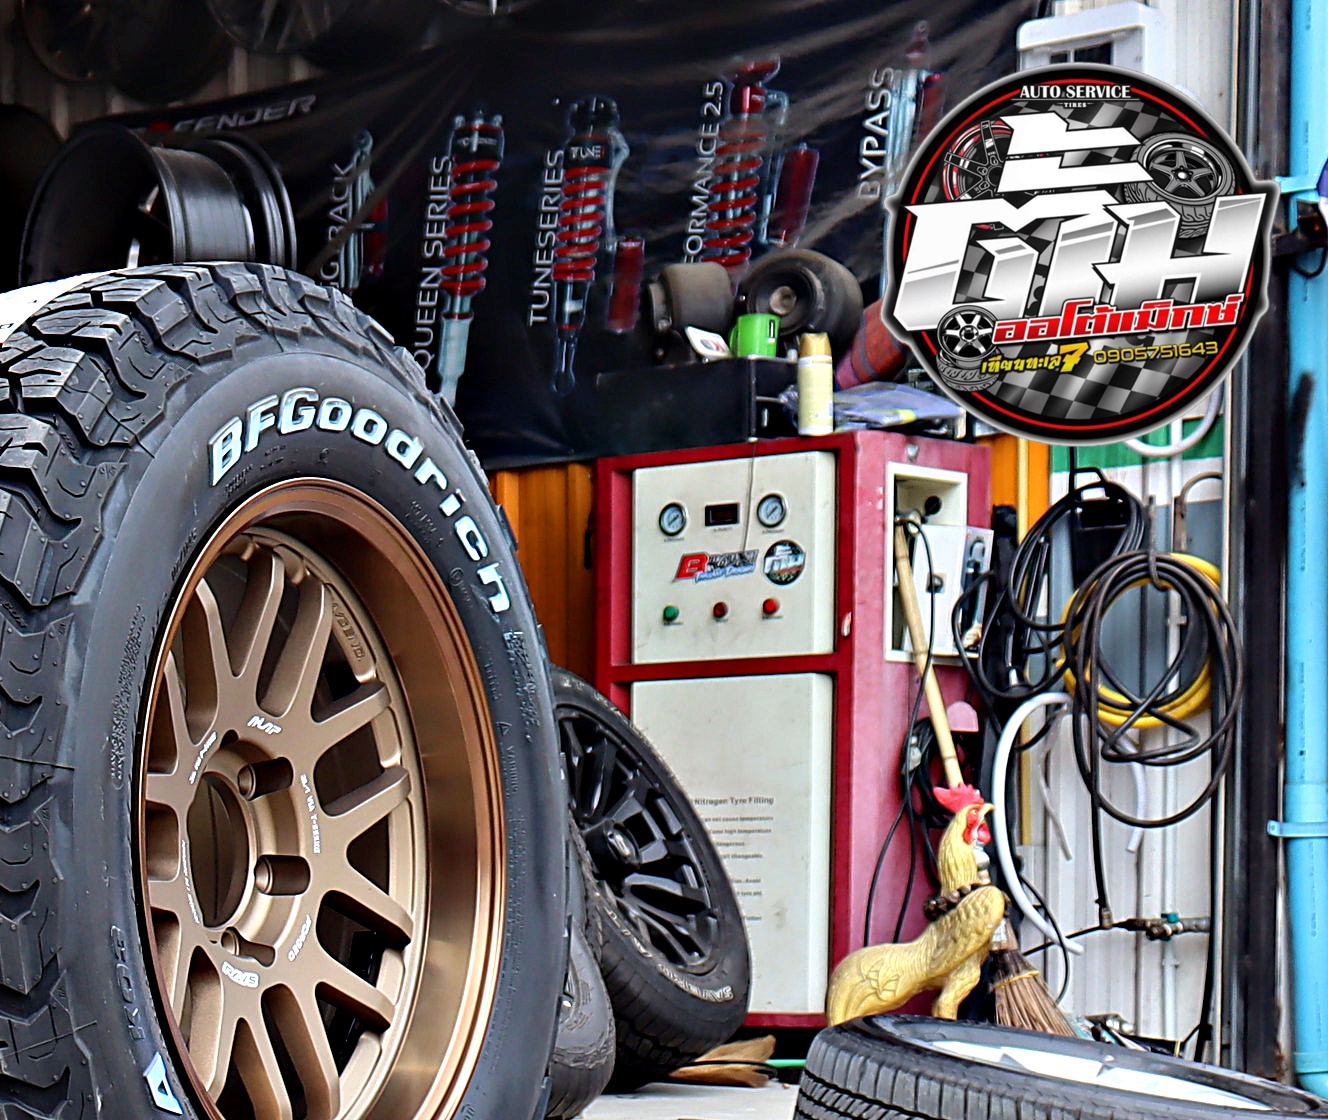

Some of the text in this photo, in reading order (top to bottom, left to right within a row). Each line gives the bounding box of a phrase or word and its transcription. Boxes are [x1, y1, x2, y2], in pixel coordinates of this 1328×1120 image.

[684, 81, 723, 264] FORMANCE 2.5
[857, 67, 895, 200] BYPASS
[413, 157, 452, 368] QUEEN SERIES
[208, 386, 514, 615] BFGoodrich
